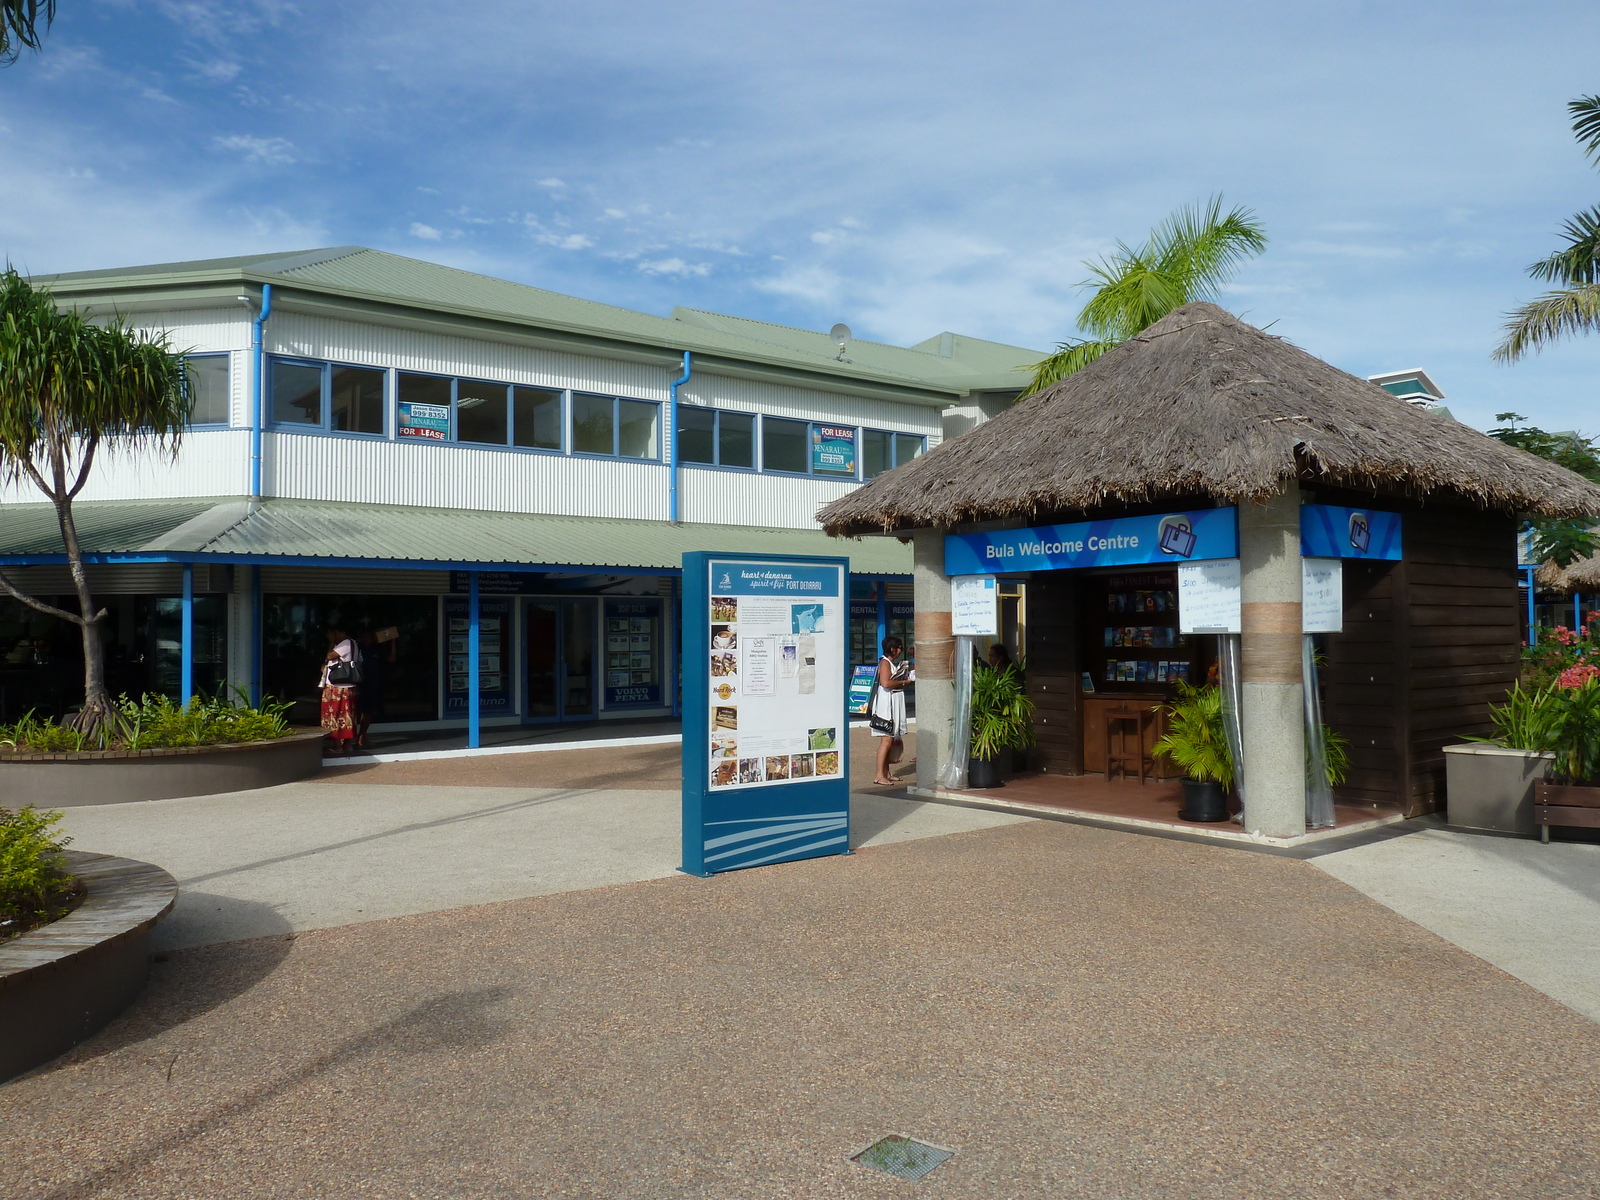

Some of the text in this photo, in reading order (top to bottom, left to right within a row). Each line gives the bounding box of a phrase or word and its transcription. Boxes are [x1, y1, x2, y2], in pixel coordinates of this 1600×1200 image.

[421, 429, 446, 440] LEASE
[821, 428, 853, 438] FOR LEASE
[814, 445, 842, 454] DENARAU
[986, 535, 1138, 558] Bula Welcome Centre
[741, 570, 760, 578] heart
[765, 571, 792, 579] denarau
[750, 579, 769, 588] spirit
[1125, 576, 1151, 585] FINEST
[786, 581, 822, 590] PORT DENARAU
[482, 604, 508, 612] SERVICES
[618, 605, 646, 613] BOAT SALES
